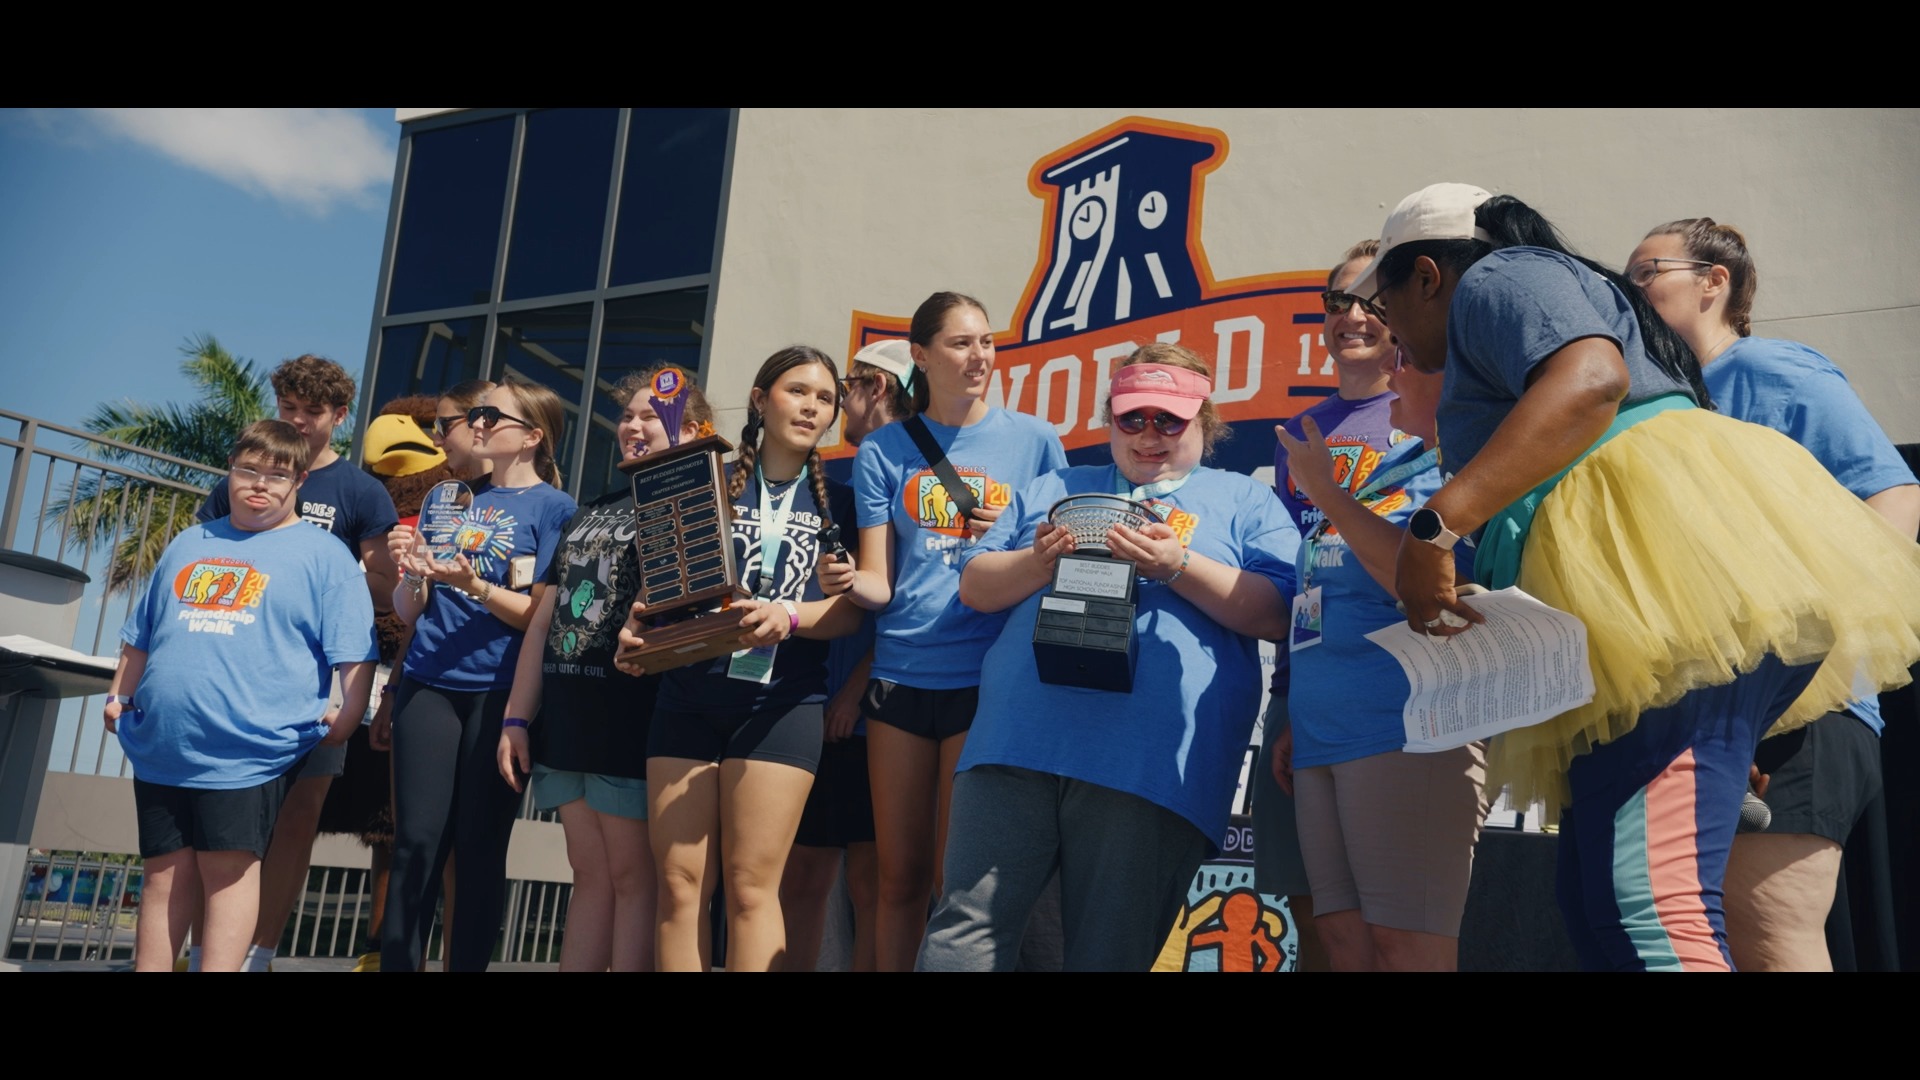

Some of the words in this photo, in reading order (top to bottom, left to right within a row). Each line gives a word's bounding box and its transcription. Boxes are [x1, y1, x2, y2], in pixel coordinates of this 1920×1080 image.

[984, 315, 1265, 437] WORD
[990, 483, 1011, 505] 20
[302, 501, 336, 517] DIES
[1301, 507, 1326, 525] Frie
[1172, 513, 1200, 529] 20
[245, 572, 270, 592] 20
[239, 588, 263, 608] 26
[178, 608, 256, 625] Friendship
[188, 619, 236, 636] Walk
